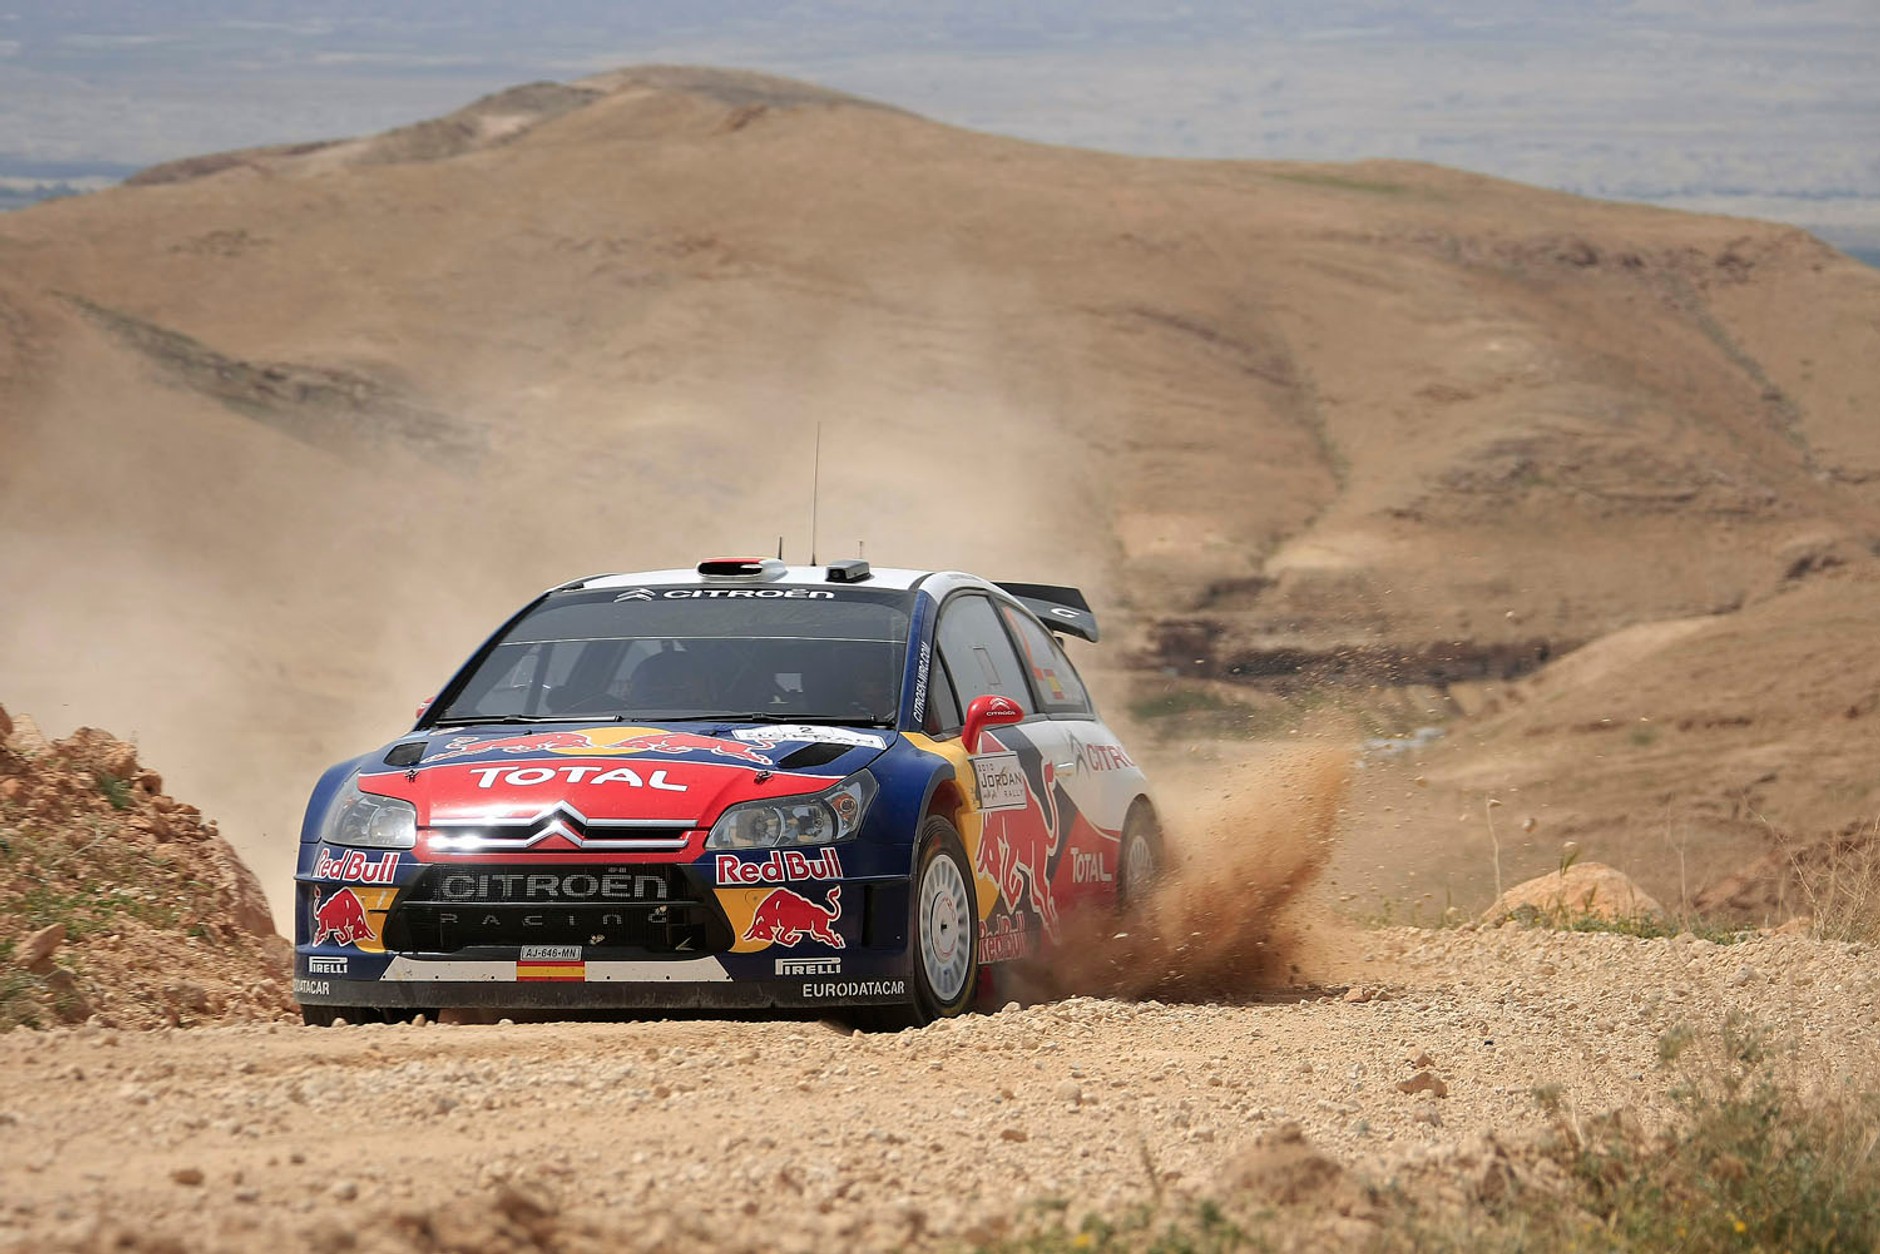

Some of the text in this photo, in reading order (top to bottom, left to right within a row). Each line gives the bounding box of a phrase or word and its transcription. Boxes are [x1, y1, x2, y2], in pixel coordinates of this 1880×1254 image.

[469, 766, 688, 792] TOTAL
[981, 772, 1023, 789] JORDAN
[312, 848, 401, 884] Red Bull
[716, 847, 843, 885] Red Bull
[1070, 847, 1112, 883] TOTAL
[309, 956, 348, 973] PIRELLI
[775, 957, 841, 975] PIRELLI
[803, 981, 905, 997] EURODATACAR
